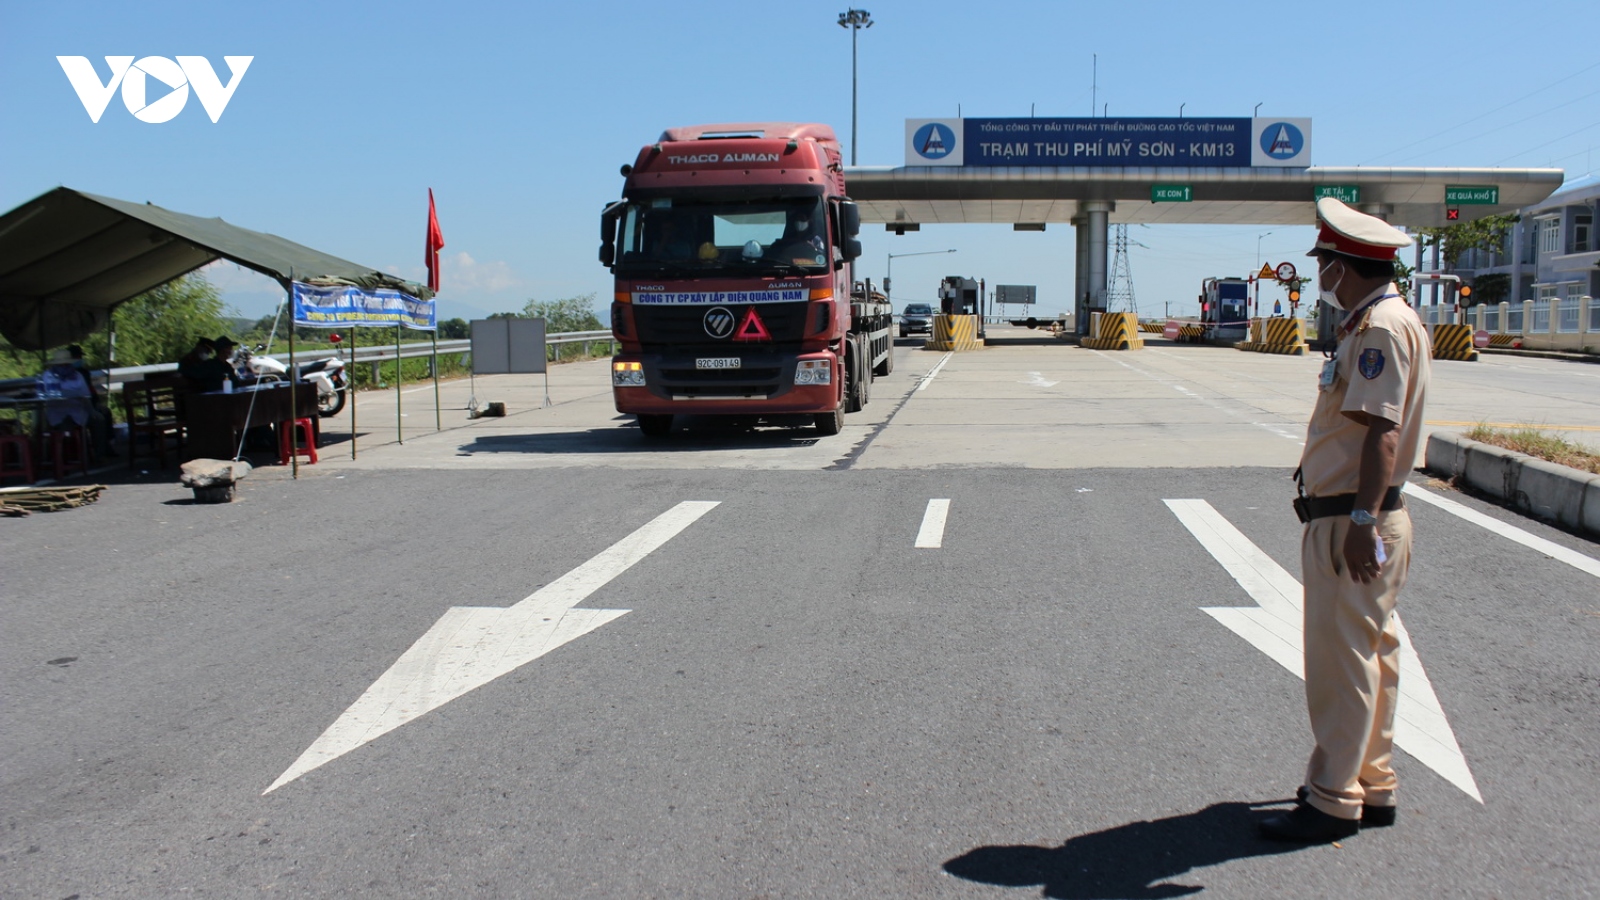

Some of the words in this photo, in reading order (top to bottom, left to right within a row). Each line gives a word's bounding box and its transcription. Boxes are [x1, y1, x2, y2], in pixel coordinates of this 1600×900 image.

[1005, 122, 1031, 132] CÔNG
[1032, 123, 1043, 132] TY
[1063, 123, 1076, 132] TƯ
[1076, 122, 1098, 132] PHÁT
[1127, 122, 1157, 132] ĐƯỜNG
[1158, 123, 1176, 132] CAO
[1177, 121, 1195, 132] TỐC
[1196, 123, 1215, 133] VIỆT
[1216, 124, 1235, 132] NAM
[980, 142, 1029, 160] TRẠM
[1033, 142, 1069, 157] THU
[1073, 138, 1104, 157] PHÍ
[1107, 138, 1133, 157] MỸ
[1138, 141, 1175, 157] SƠN
[1189, 142, 1235, 157] KM13
[667, 154, 719, 165] THACO
[722, 153, 780, 163] AUMAN
[1156, 189, 1167, 198] XE
[1167, 189, 1182, 198] CON
[1322, 187, 1332, 195] XE
[1446, 191, 1457, 200] XE
[768, 281, 802, 289] AUMAN
[639, 292, 663, 303] CÔNG
[664, 293, 676, 303] TY
[782, 290, 803, 301] NAM
